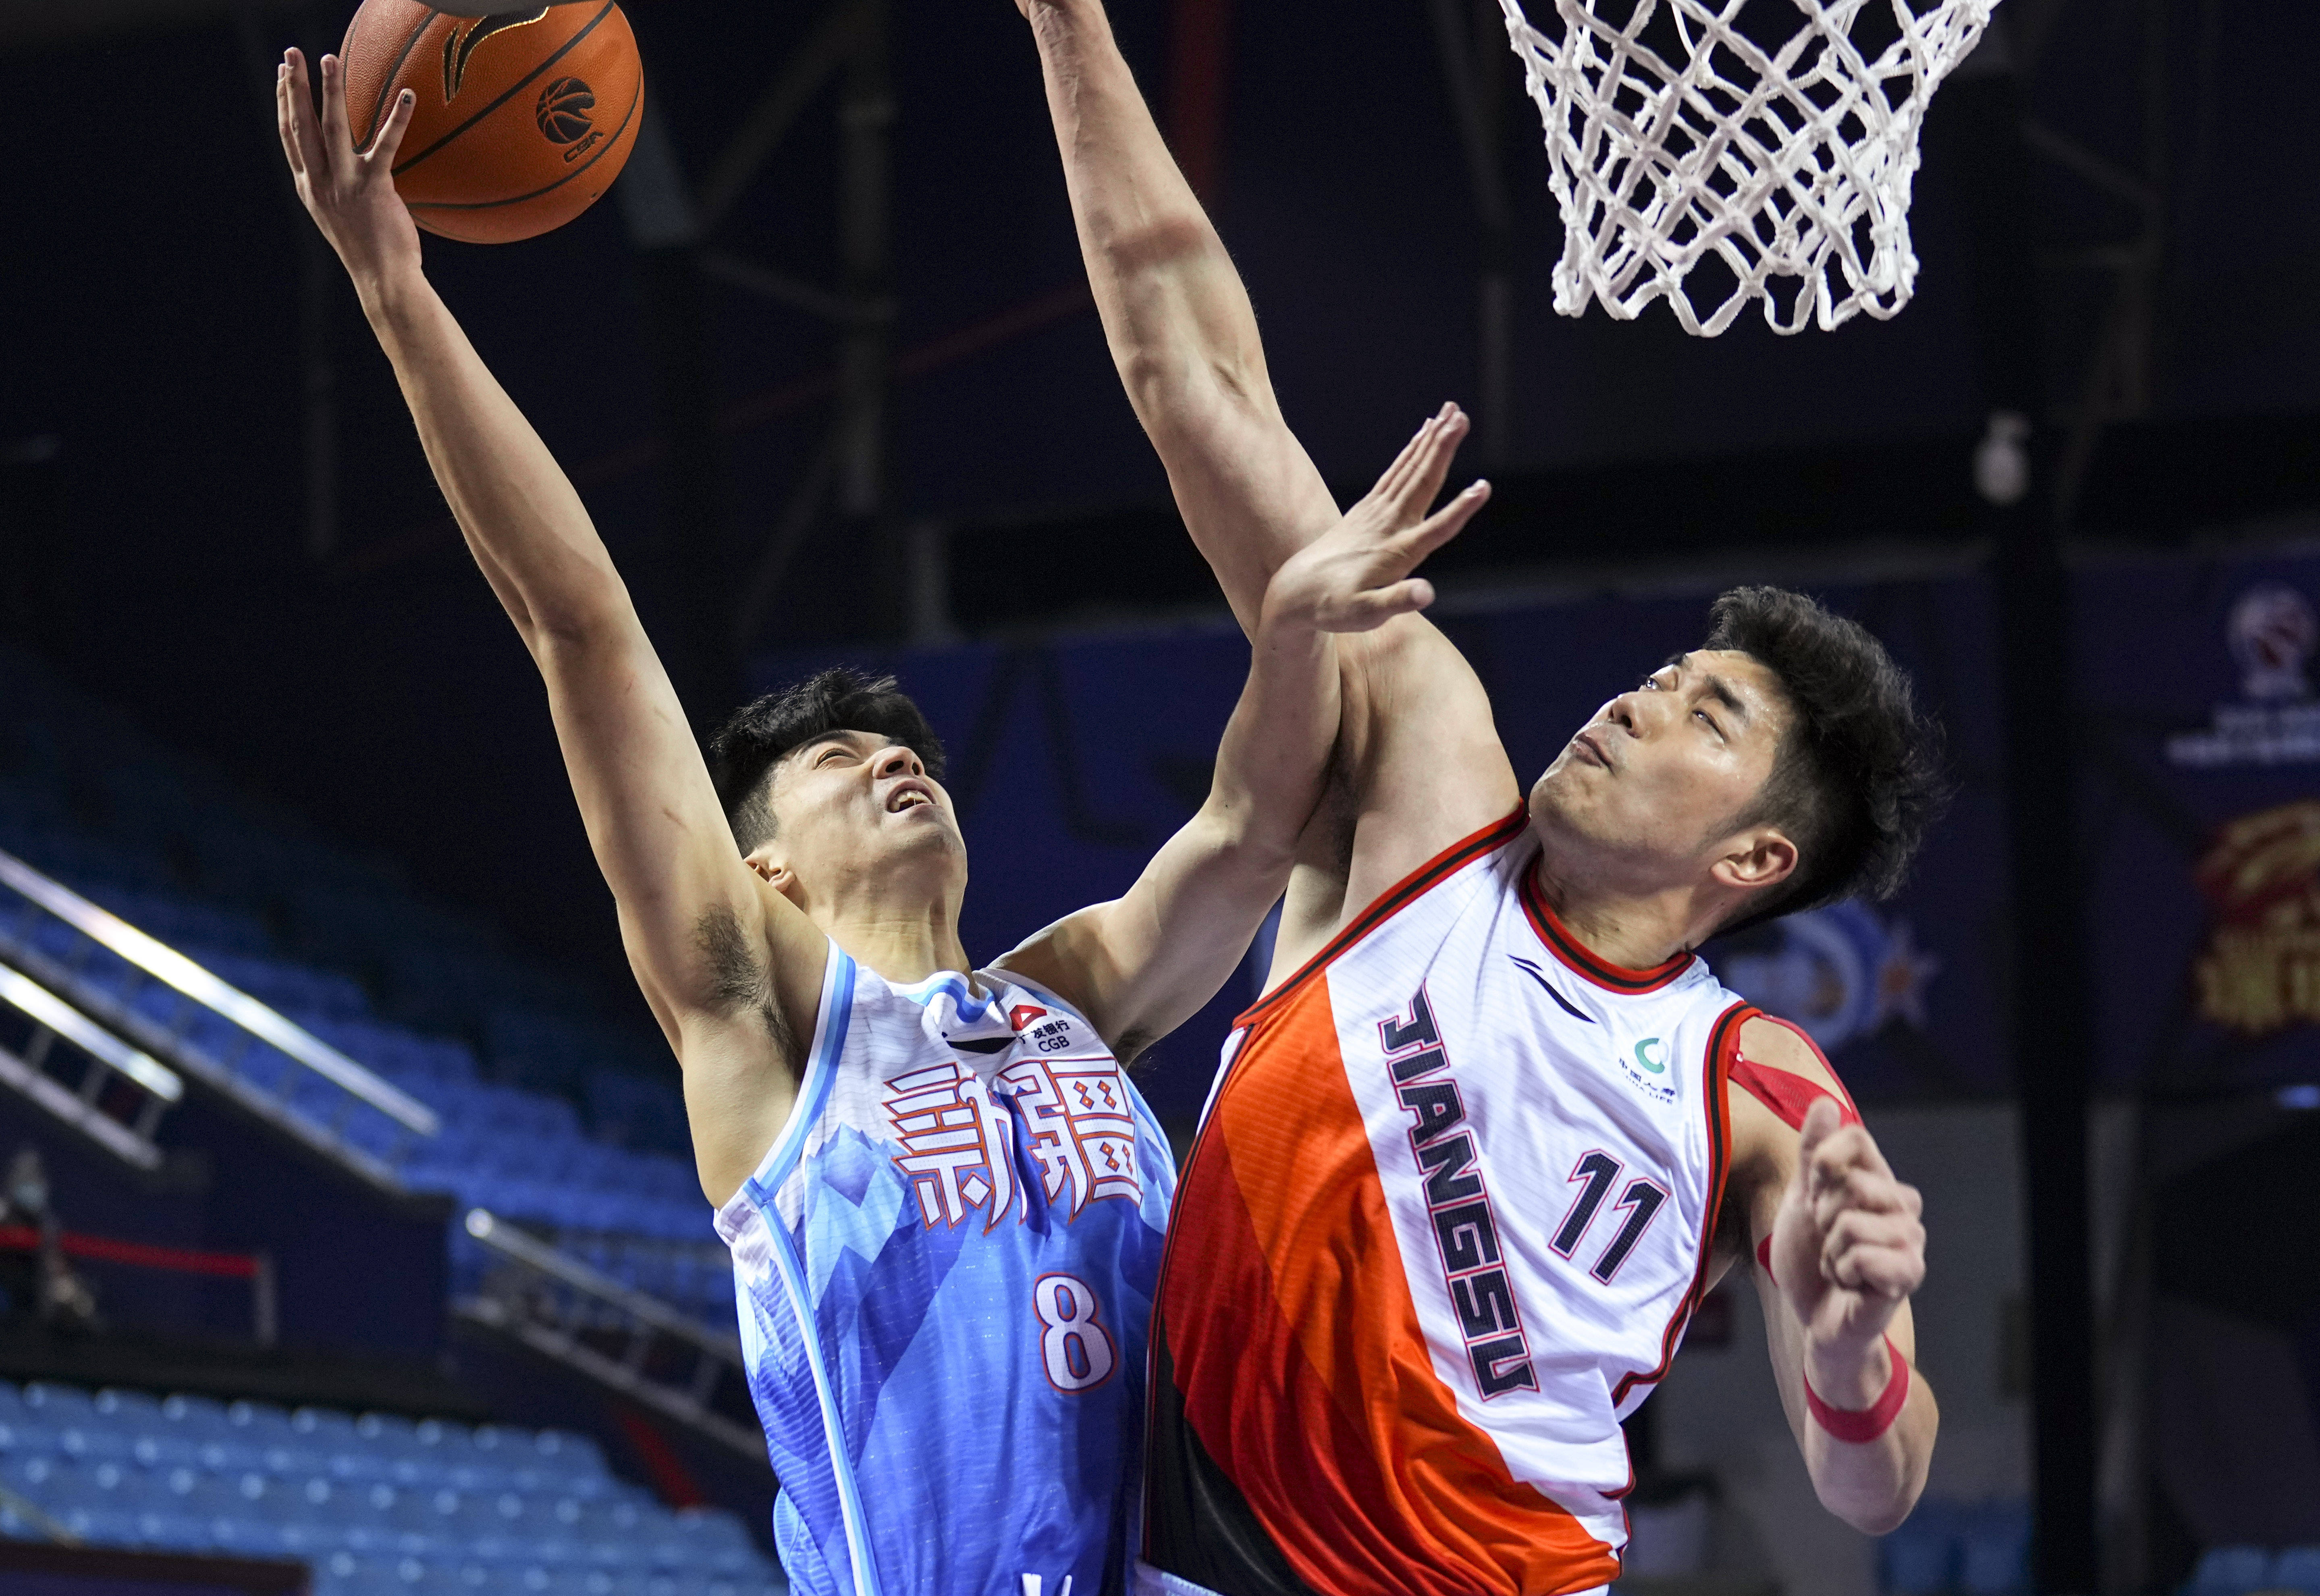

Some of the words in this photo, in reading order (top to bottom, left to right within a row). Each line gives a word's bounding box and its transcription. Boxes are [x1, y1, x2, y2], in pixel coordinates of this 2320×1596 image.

[563, 131, 603, 163] CBA
[1019, 1020, 1070, 1044] 广发银行
[1038, 1036, 1070, 1052] CGB
[881, 1056, 1144, 1237] 新疆
[1377, 977, 1539, 1401] JIANGSU
[1548, 1149, 1670, 1285] 11
[1032, 1271, 1119, 1395] 8
